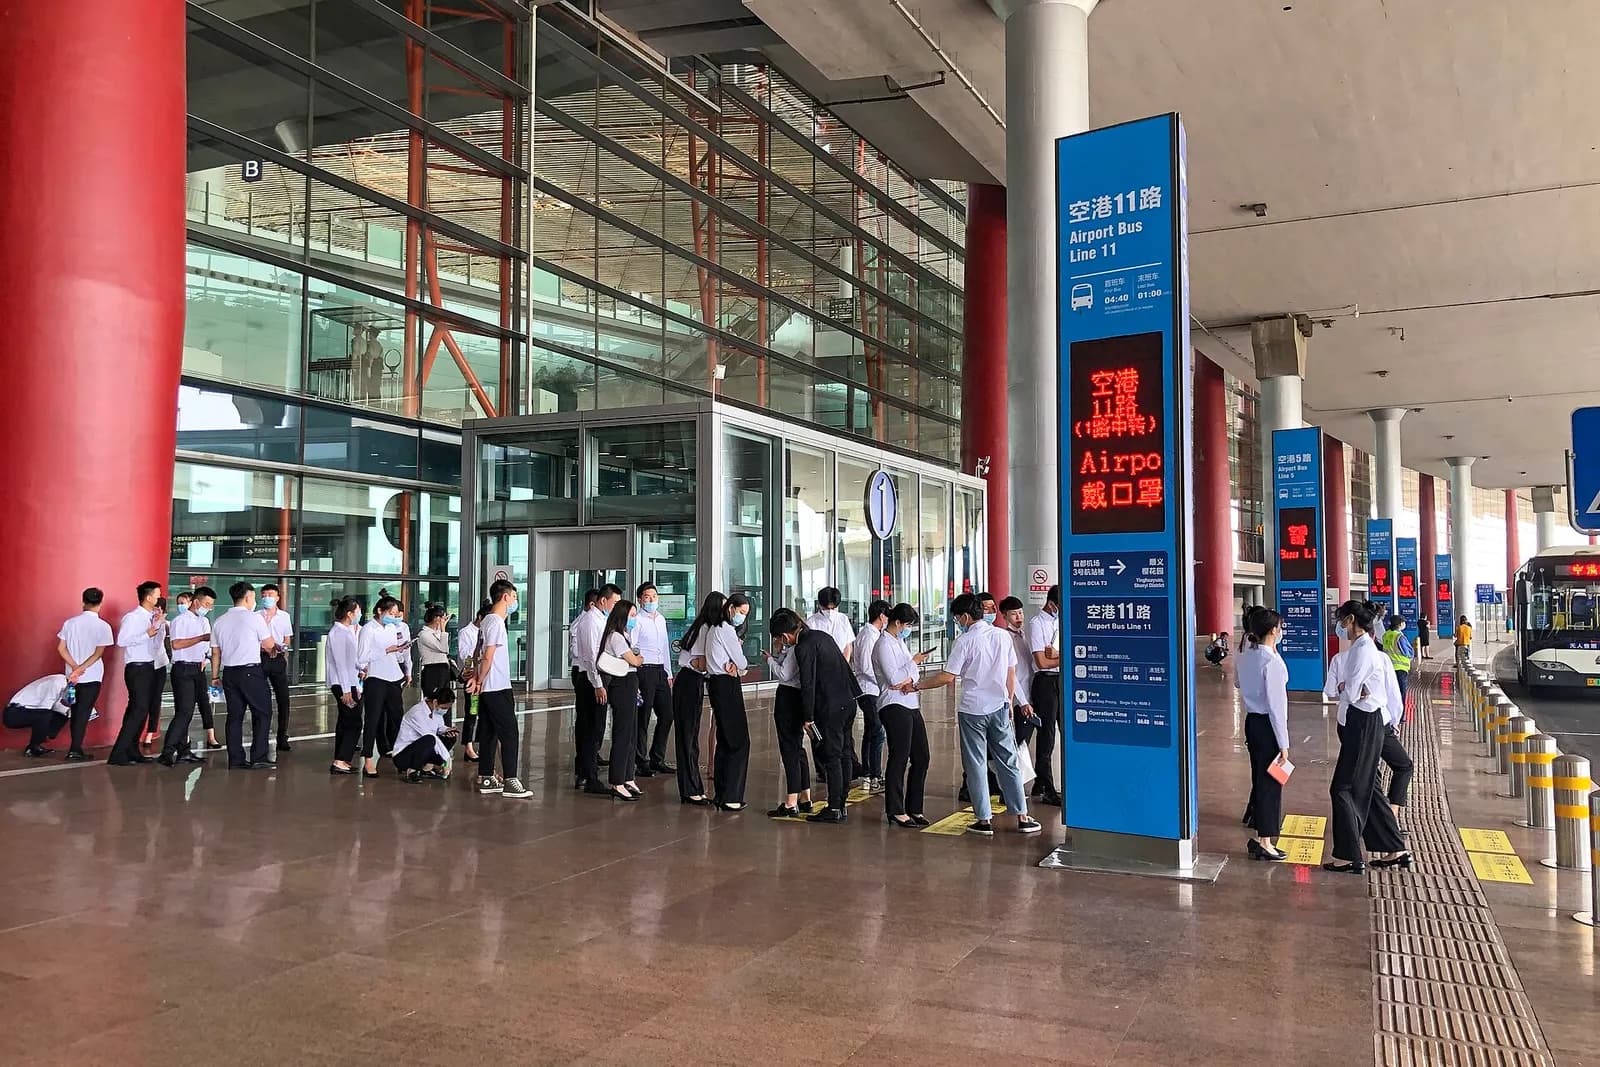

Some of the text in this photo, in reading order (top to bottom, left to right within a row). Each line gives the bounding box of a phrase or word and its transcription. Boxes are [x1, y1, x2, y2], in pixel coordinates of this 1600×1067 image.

[246, 161, 259, 177] B
[1069, 185, 1162, 223] 空港11路
[1069, 221, 1143, 245] Airport Bus
[1070, 242, 1116, 263] Line 11
[1104, 294, 1129, 304] 04:40
[1138, 289, 1162, 299] 01:00
[1091, 368, 1139, 396] 空港
[1093, 393, 1139, 419] 11路
[1080, 450, 1161, 475] Airpo
[1278, 454, 1311, 464] 空港5路
[878, 478, 887, 531] 1
[1081, 478, 1163, 510] 戴口罩
[1087, 602, 1151, 620] 空港11路
[1087, 623, 1111, 631] Airport
